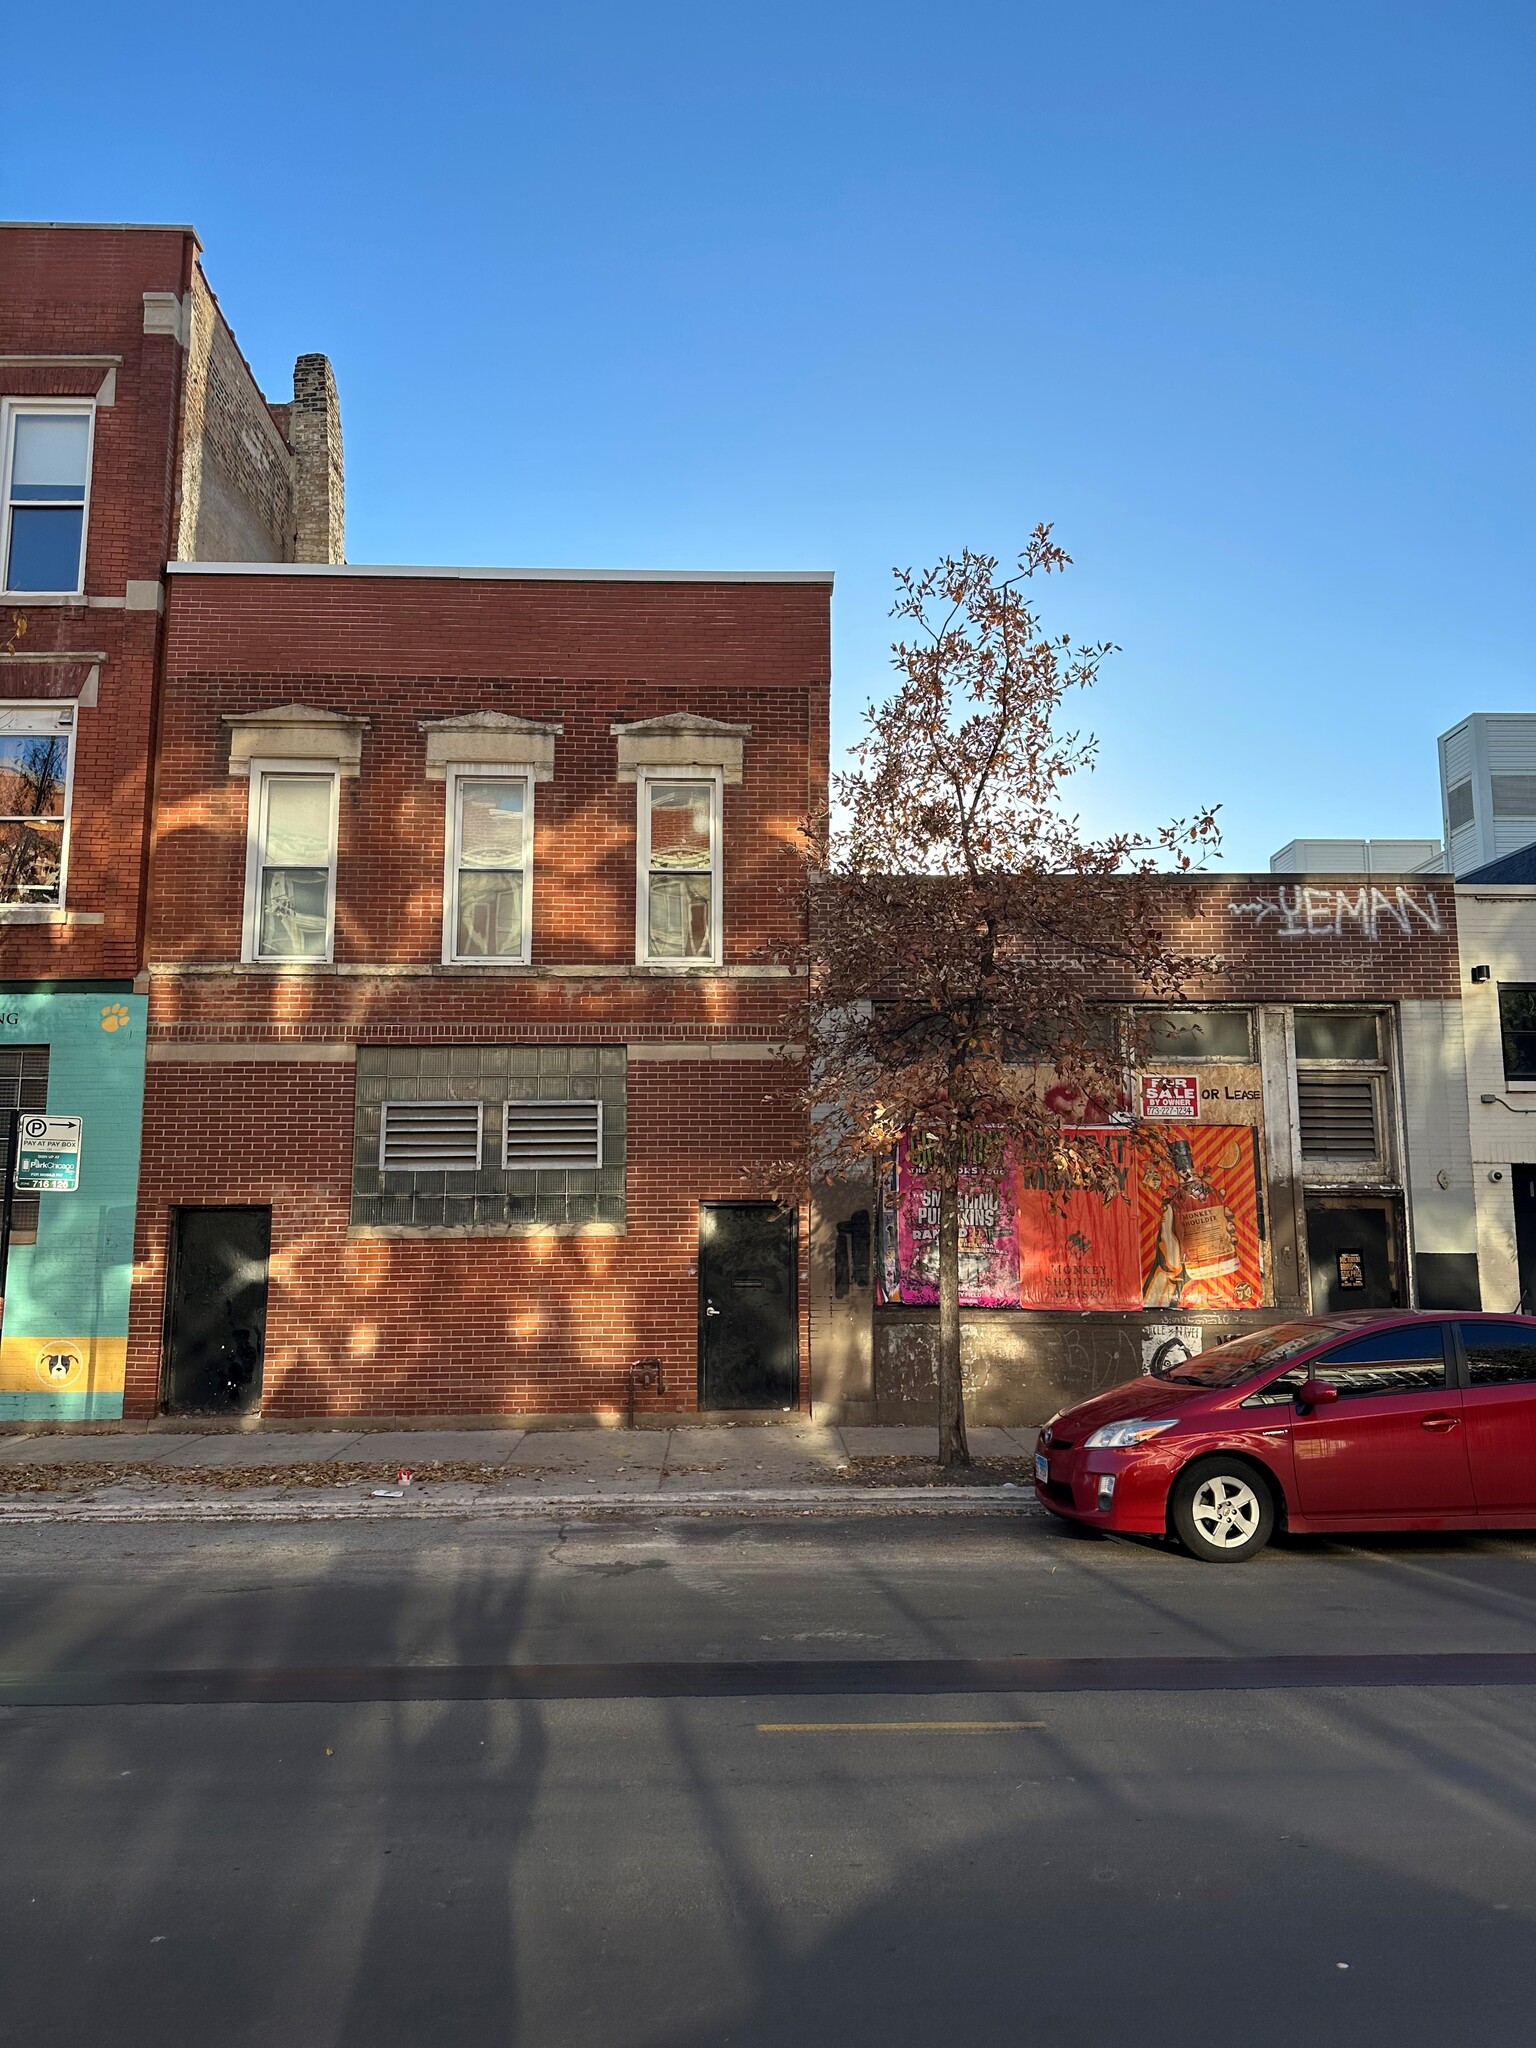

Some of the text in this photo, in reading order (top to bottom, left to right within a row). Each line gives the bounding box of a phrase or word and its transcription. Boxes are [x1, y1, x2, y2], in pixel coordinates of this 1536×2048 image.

[1146, 1088, 1195, 1099] SALE
[1201, 1086, 1261, 1100] OR LEASE
[1147, 1106, 1193, 1116] 773-227-1234
[922, 1190, 999, 1211] SMHING
[918, 1207, 995, 1227] PUKINS
[1182, 1209, 1213, 1220] MONKEY
[912, 1228, 968, 1240] RAND
[1051, 1264, 1107, 1275] MONKEY
[1045, 1276, 1114, 1287] SHOULDER
[1054, 1289, 1106, 1299] WHISKY
